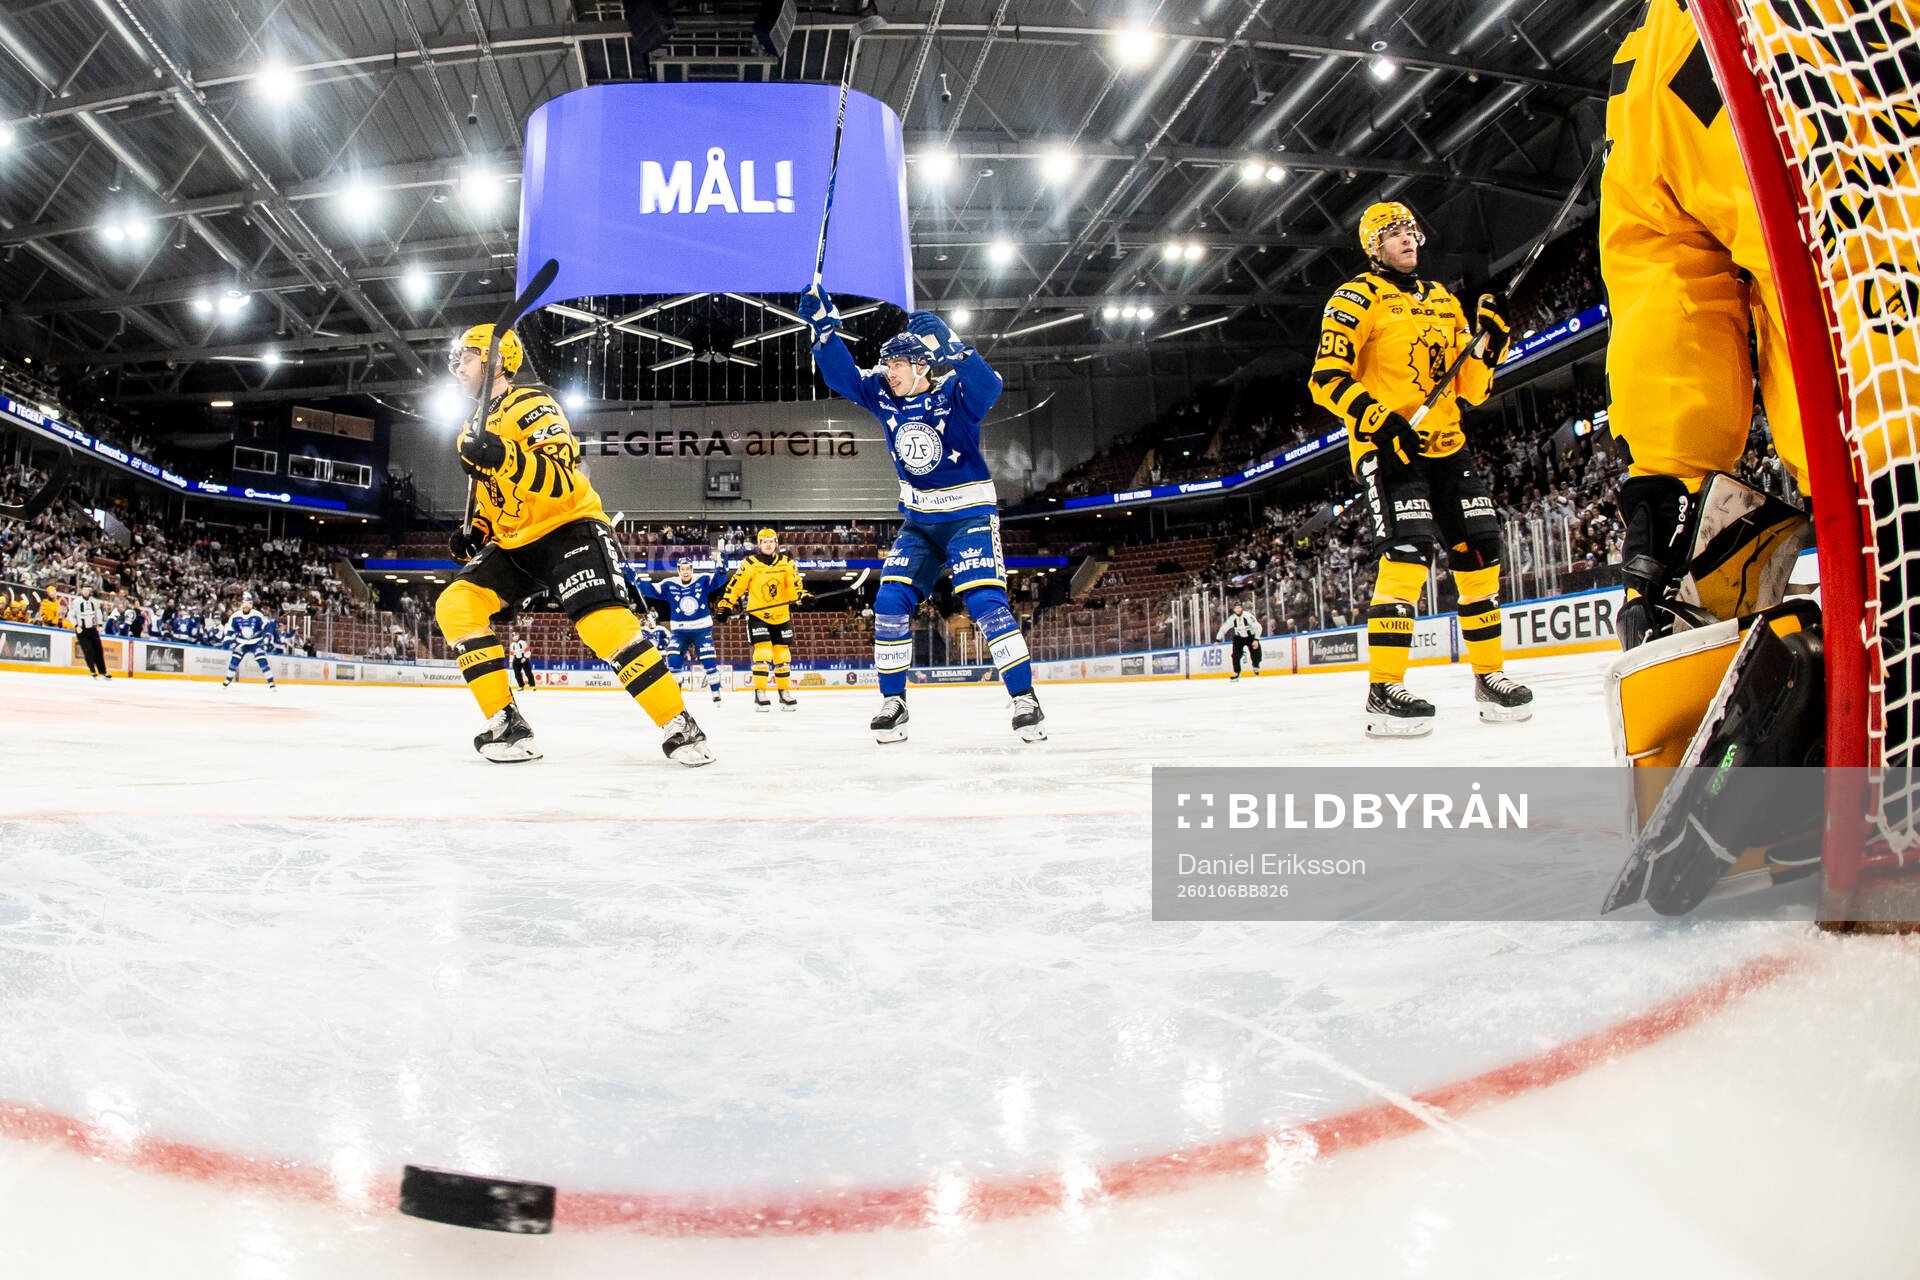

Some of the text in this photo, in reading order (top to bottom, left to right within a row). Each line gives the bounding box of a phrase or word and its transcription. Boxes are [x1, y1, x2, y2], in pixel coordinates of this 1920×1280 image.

[640, 147, 795, 214] MÅL!
[1321, 330, 1349, 358] 96
[924, 398, 932, 411] C
[745, 430, 858, 457] arena
[564, 545, 590, 559] CCM
[952, 557, 995, 575] SAFE4U
[558, 568, 596, 593] BASTU
[561, 578, 606, 602] PRODUKTER
[1379, 620, 1410, 631] NORR
[1510, 598, 1615, 646] TEGER
[1410, 632, 1437, 648] LTEC
[14, 641, 48, 659] Adven
[1201, 649, 1222, 667] AEB
